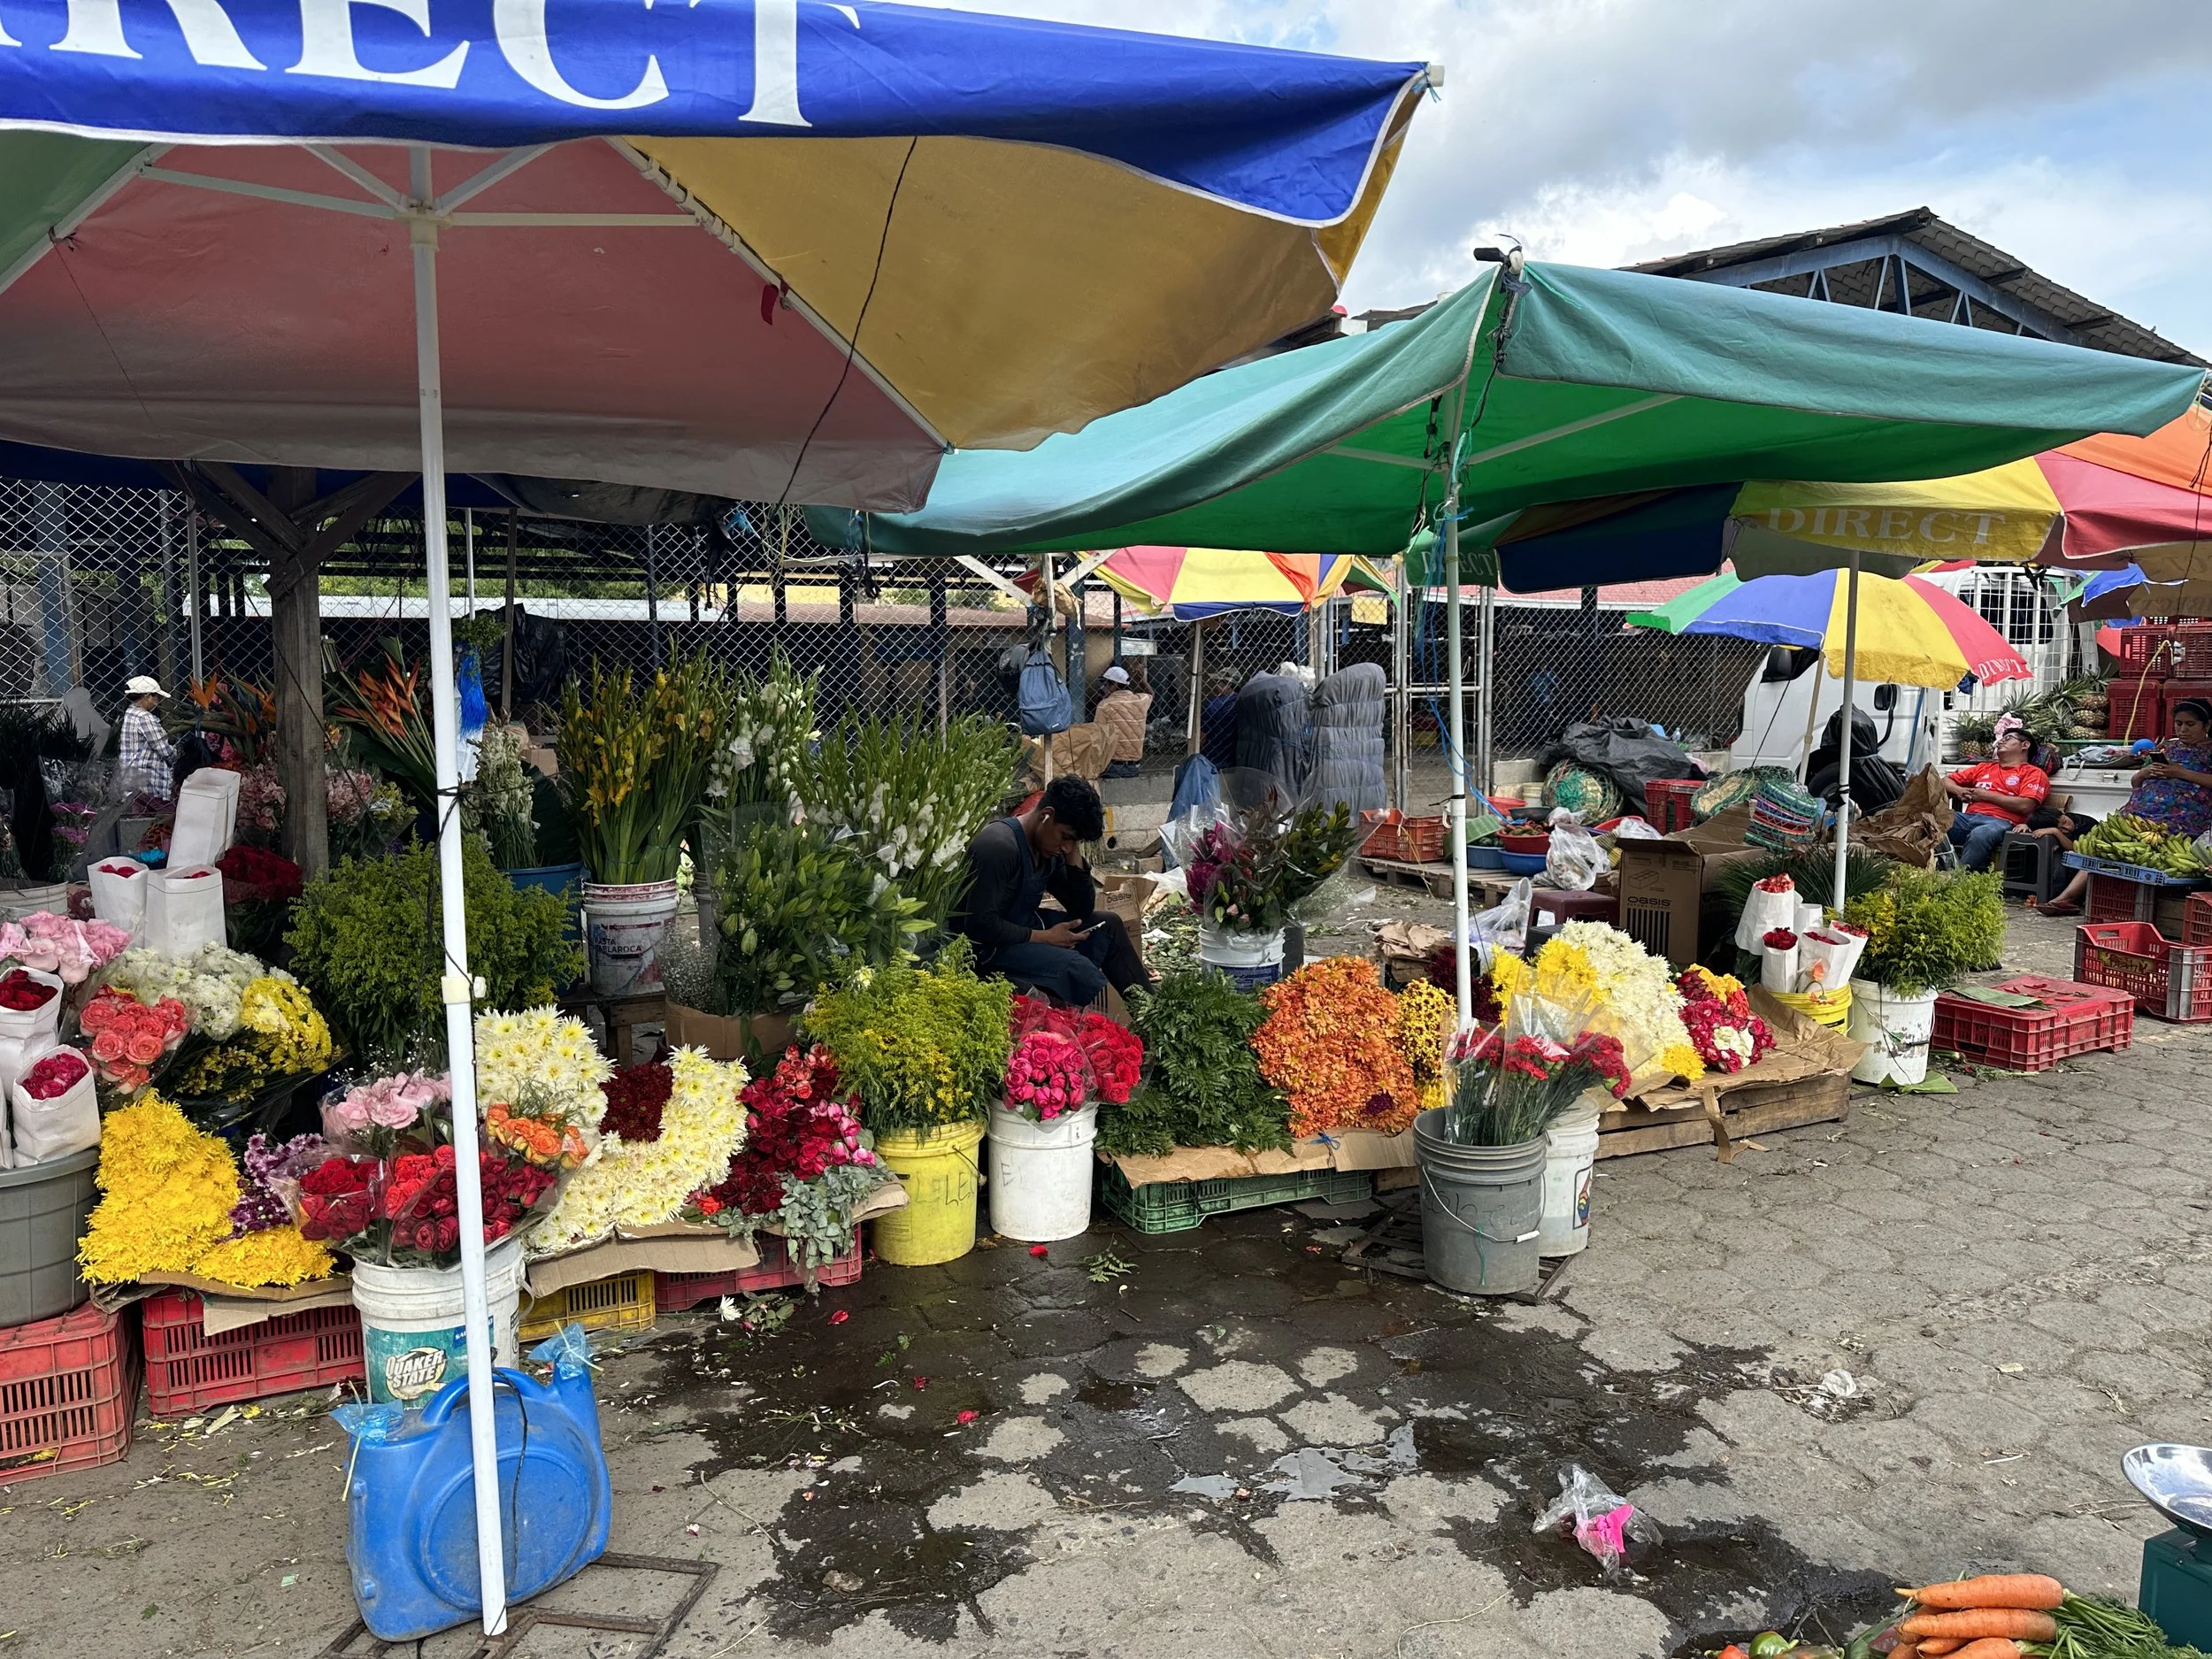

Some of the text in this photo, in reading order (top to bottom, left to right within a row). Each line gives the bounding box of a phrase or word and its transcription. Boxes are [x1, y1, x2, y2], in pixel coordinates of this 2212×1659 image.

[1769, 507, 2006, 546] DIRECT
[1421, 550, 1494, 577] DECT
[385, 1348, 446, 1380] QUAKER
[392, 1365, 436, 1389] STATE
